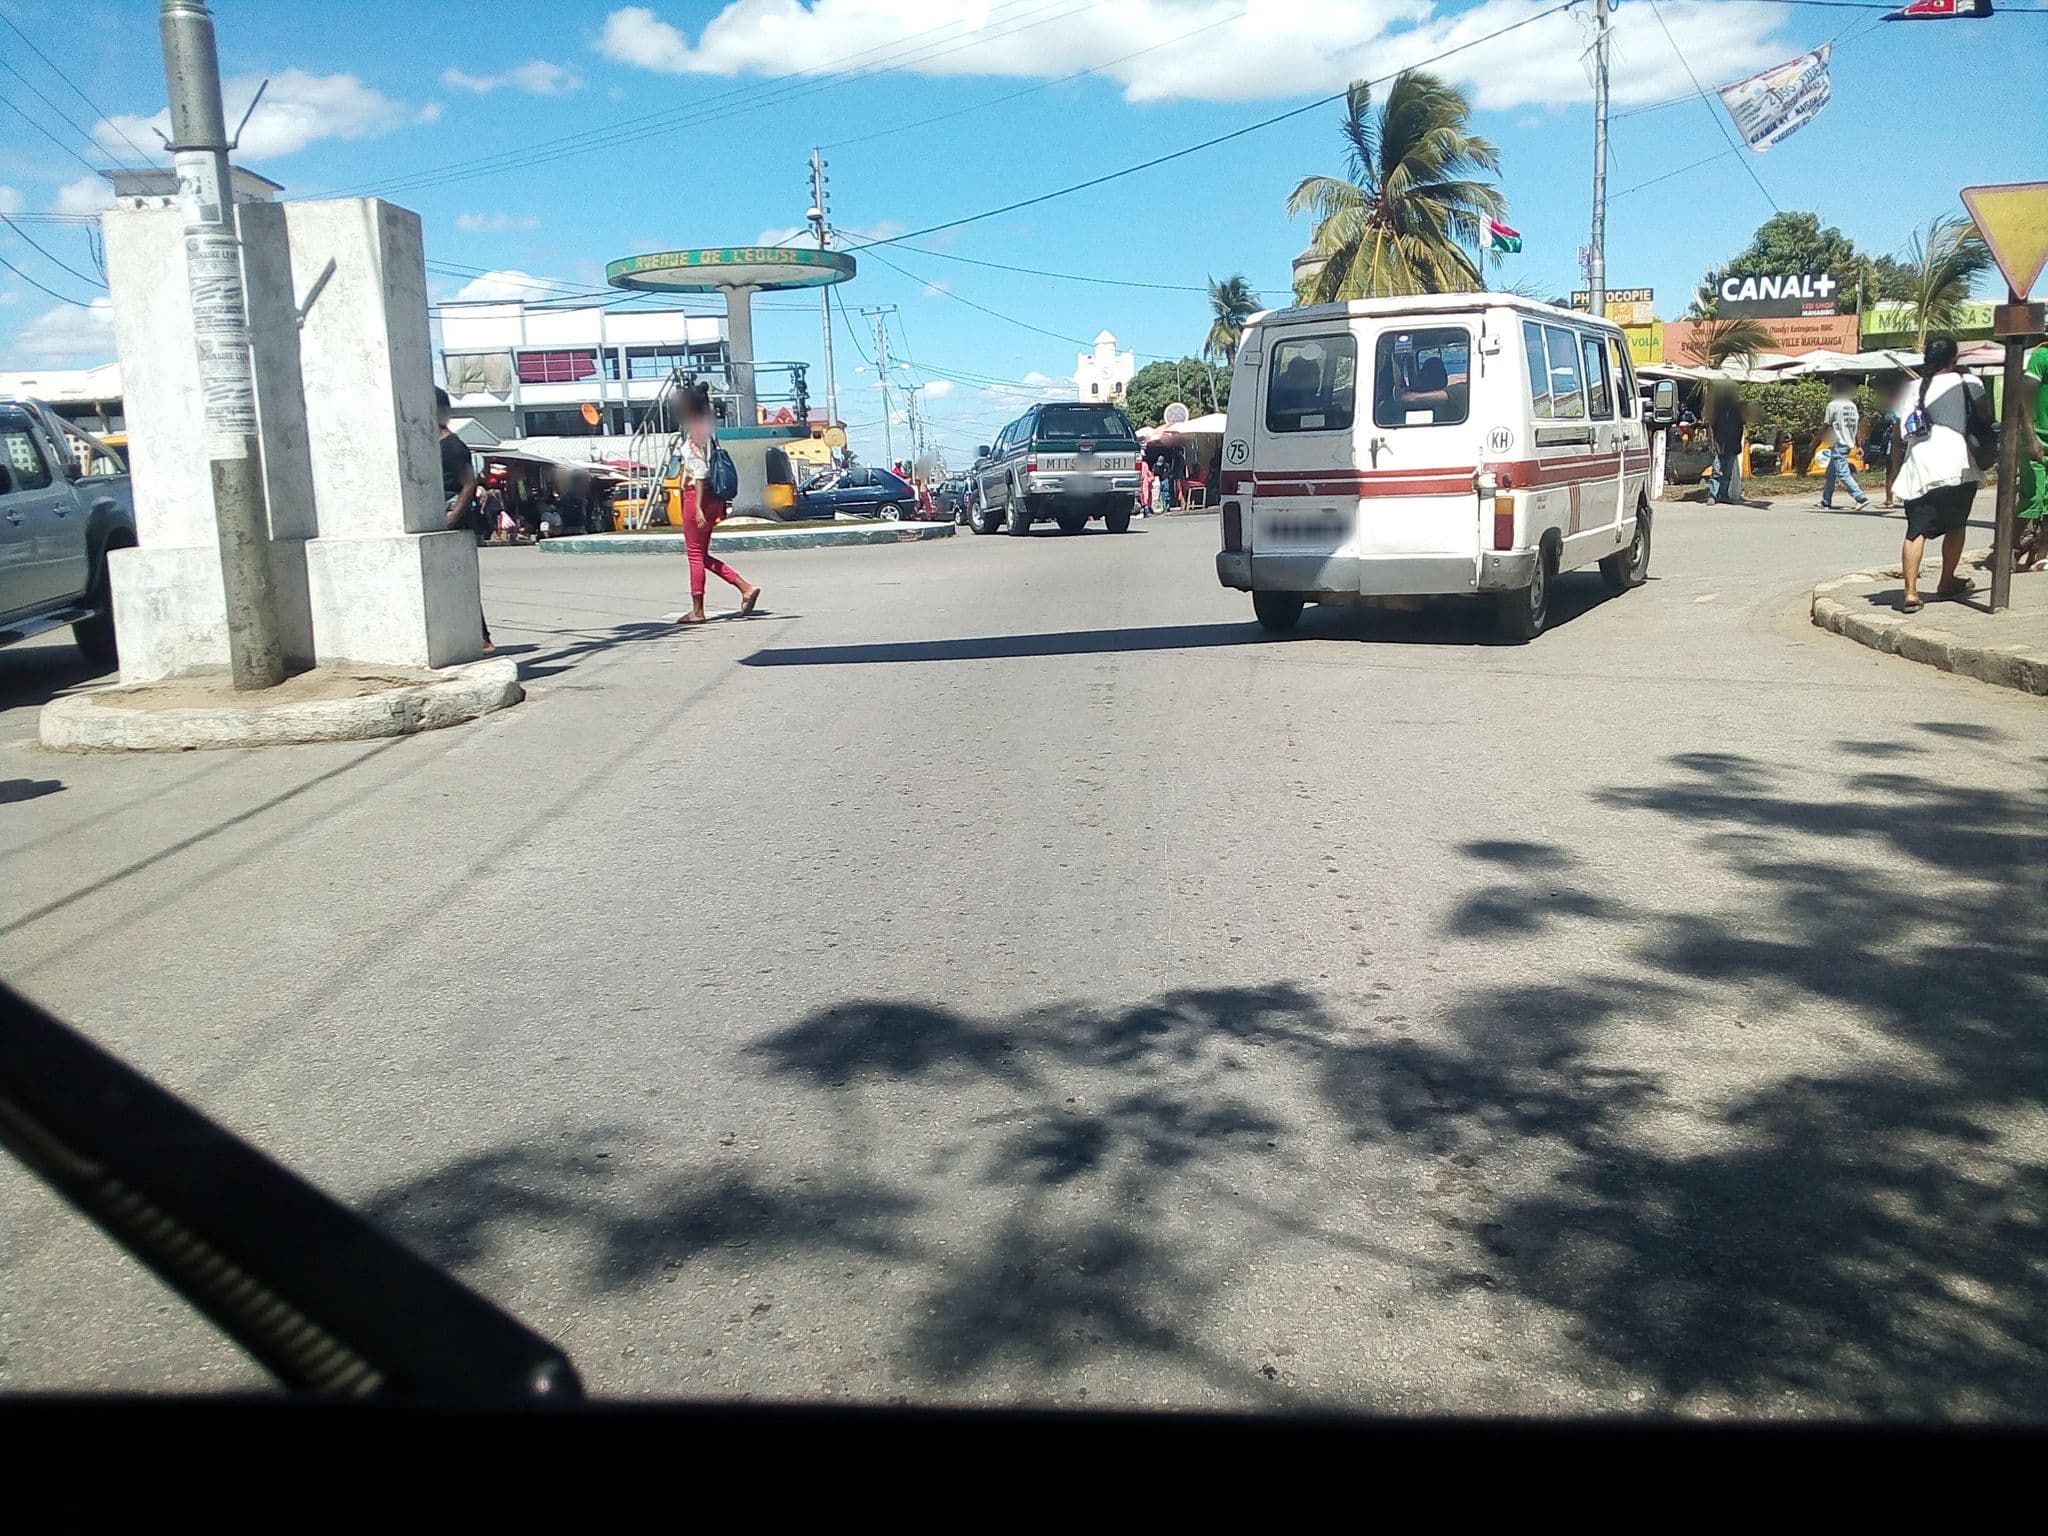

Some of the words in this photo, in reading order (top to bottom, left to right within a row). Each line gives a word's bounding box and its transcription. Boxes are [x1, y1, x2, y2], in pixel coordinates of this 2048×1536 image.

[635, 252, 688, 269] AVENUE
[702, 250, 721, 264] DE
[1721, 274, 1836, 302] CANAL+
[1573, 289, 1652, 304] PHOCOPIE
[1491, 432, 1508, 448] KH
[1231, 444, 1244, 460] 75
[1046, 458, 1127, 470] MITSISHI
